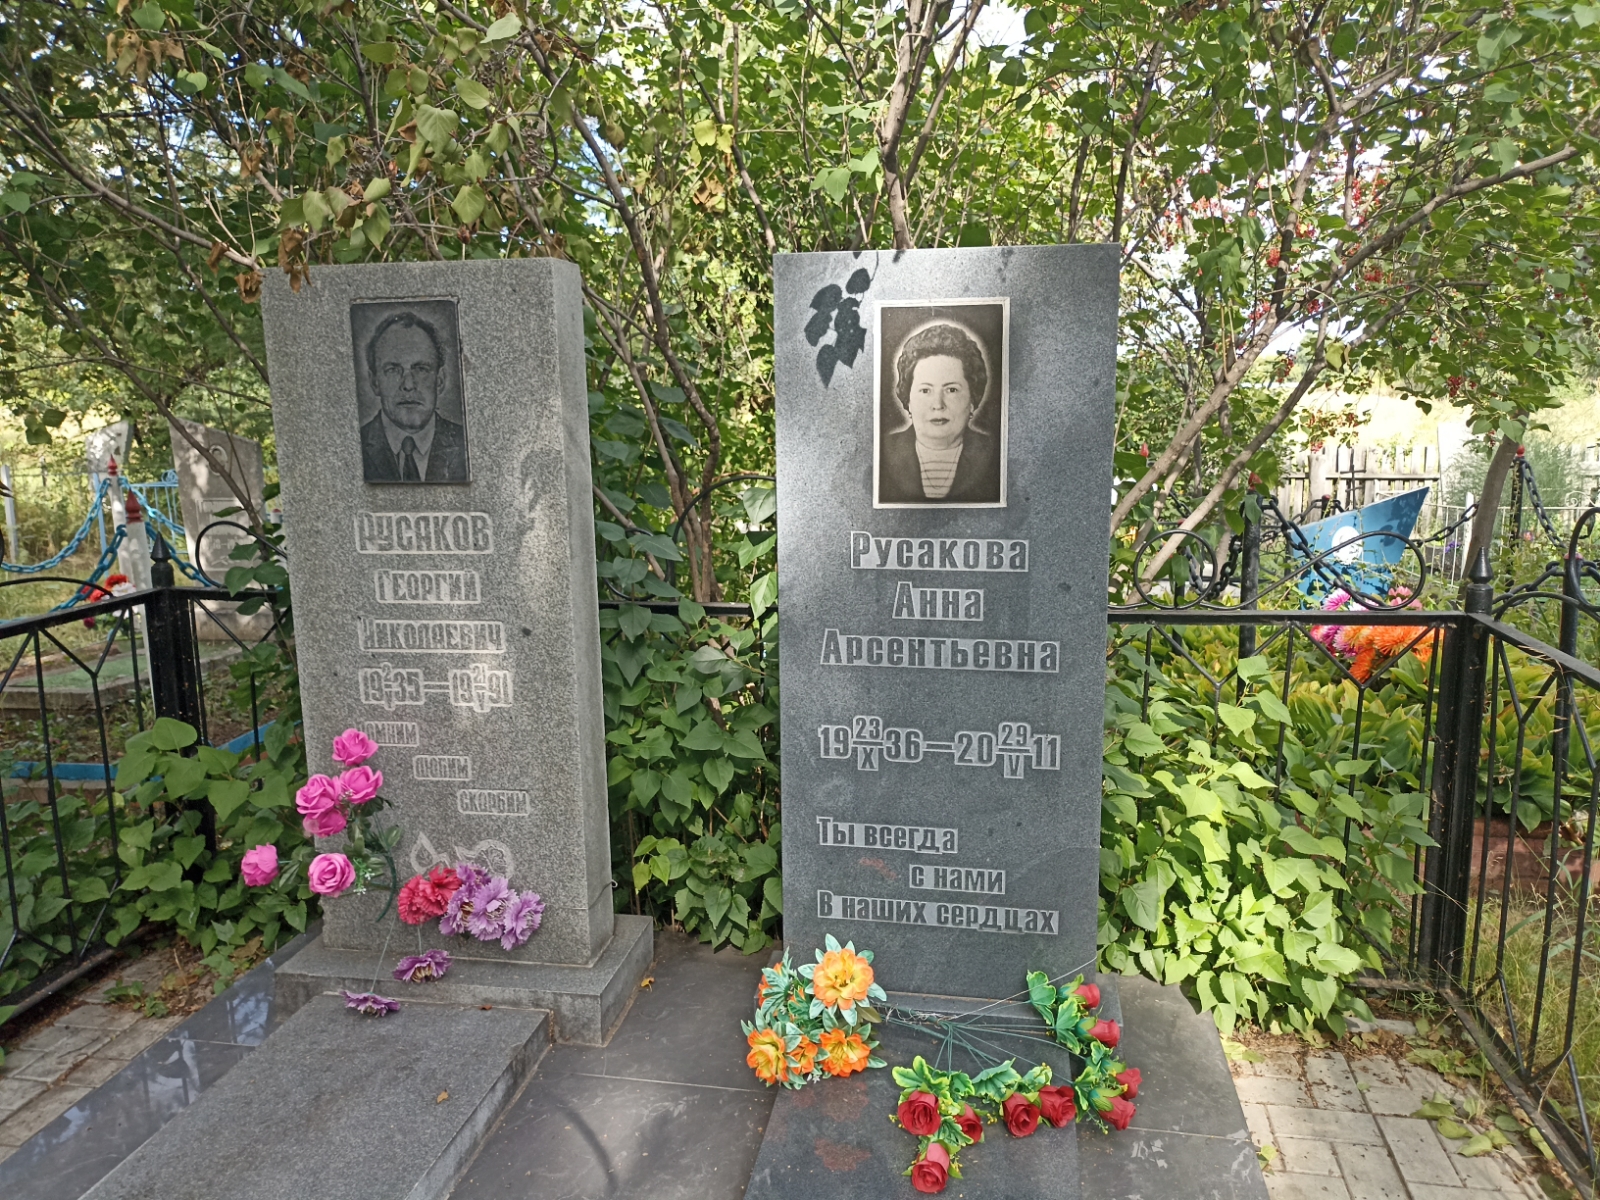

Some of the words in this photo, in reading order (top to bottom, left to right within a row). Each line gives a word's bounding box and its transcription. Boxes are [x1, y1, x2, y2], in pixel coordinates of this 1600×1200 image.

[357, 512, 492, 552] РУСАКОВ
[852, 532, 1028, 570] Русакова
[894, 582, 982, 620] Анна
[822, 629, 1058, 671] Арсентьевна
[818, 817, 856, 846] Ты
[864, 823, 957, 852] всегда
[910, 865, 925, 888] с
[933, 866, 1004, 893] нами
[818, 890, 834, 917] В
[841, 896, 927, 925] наших
[936, 903, 1055, 934] сердцах
